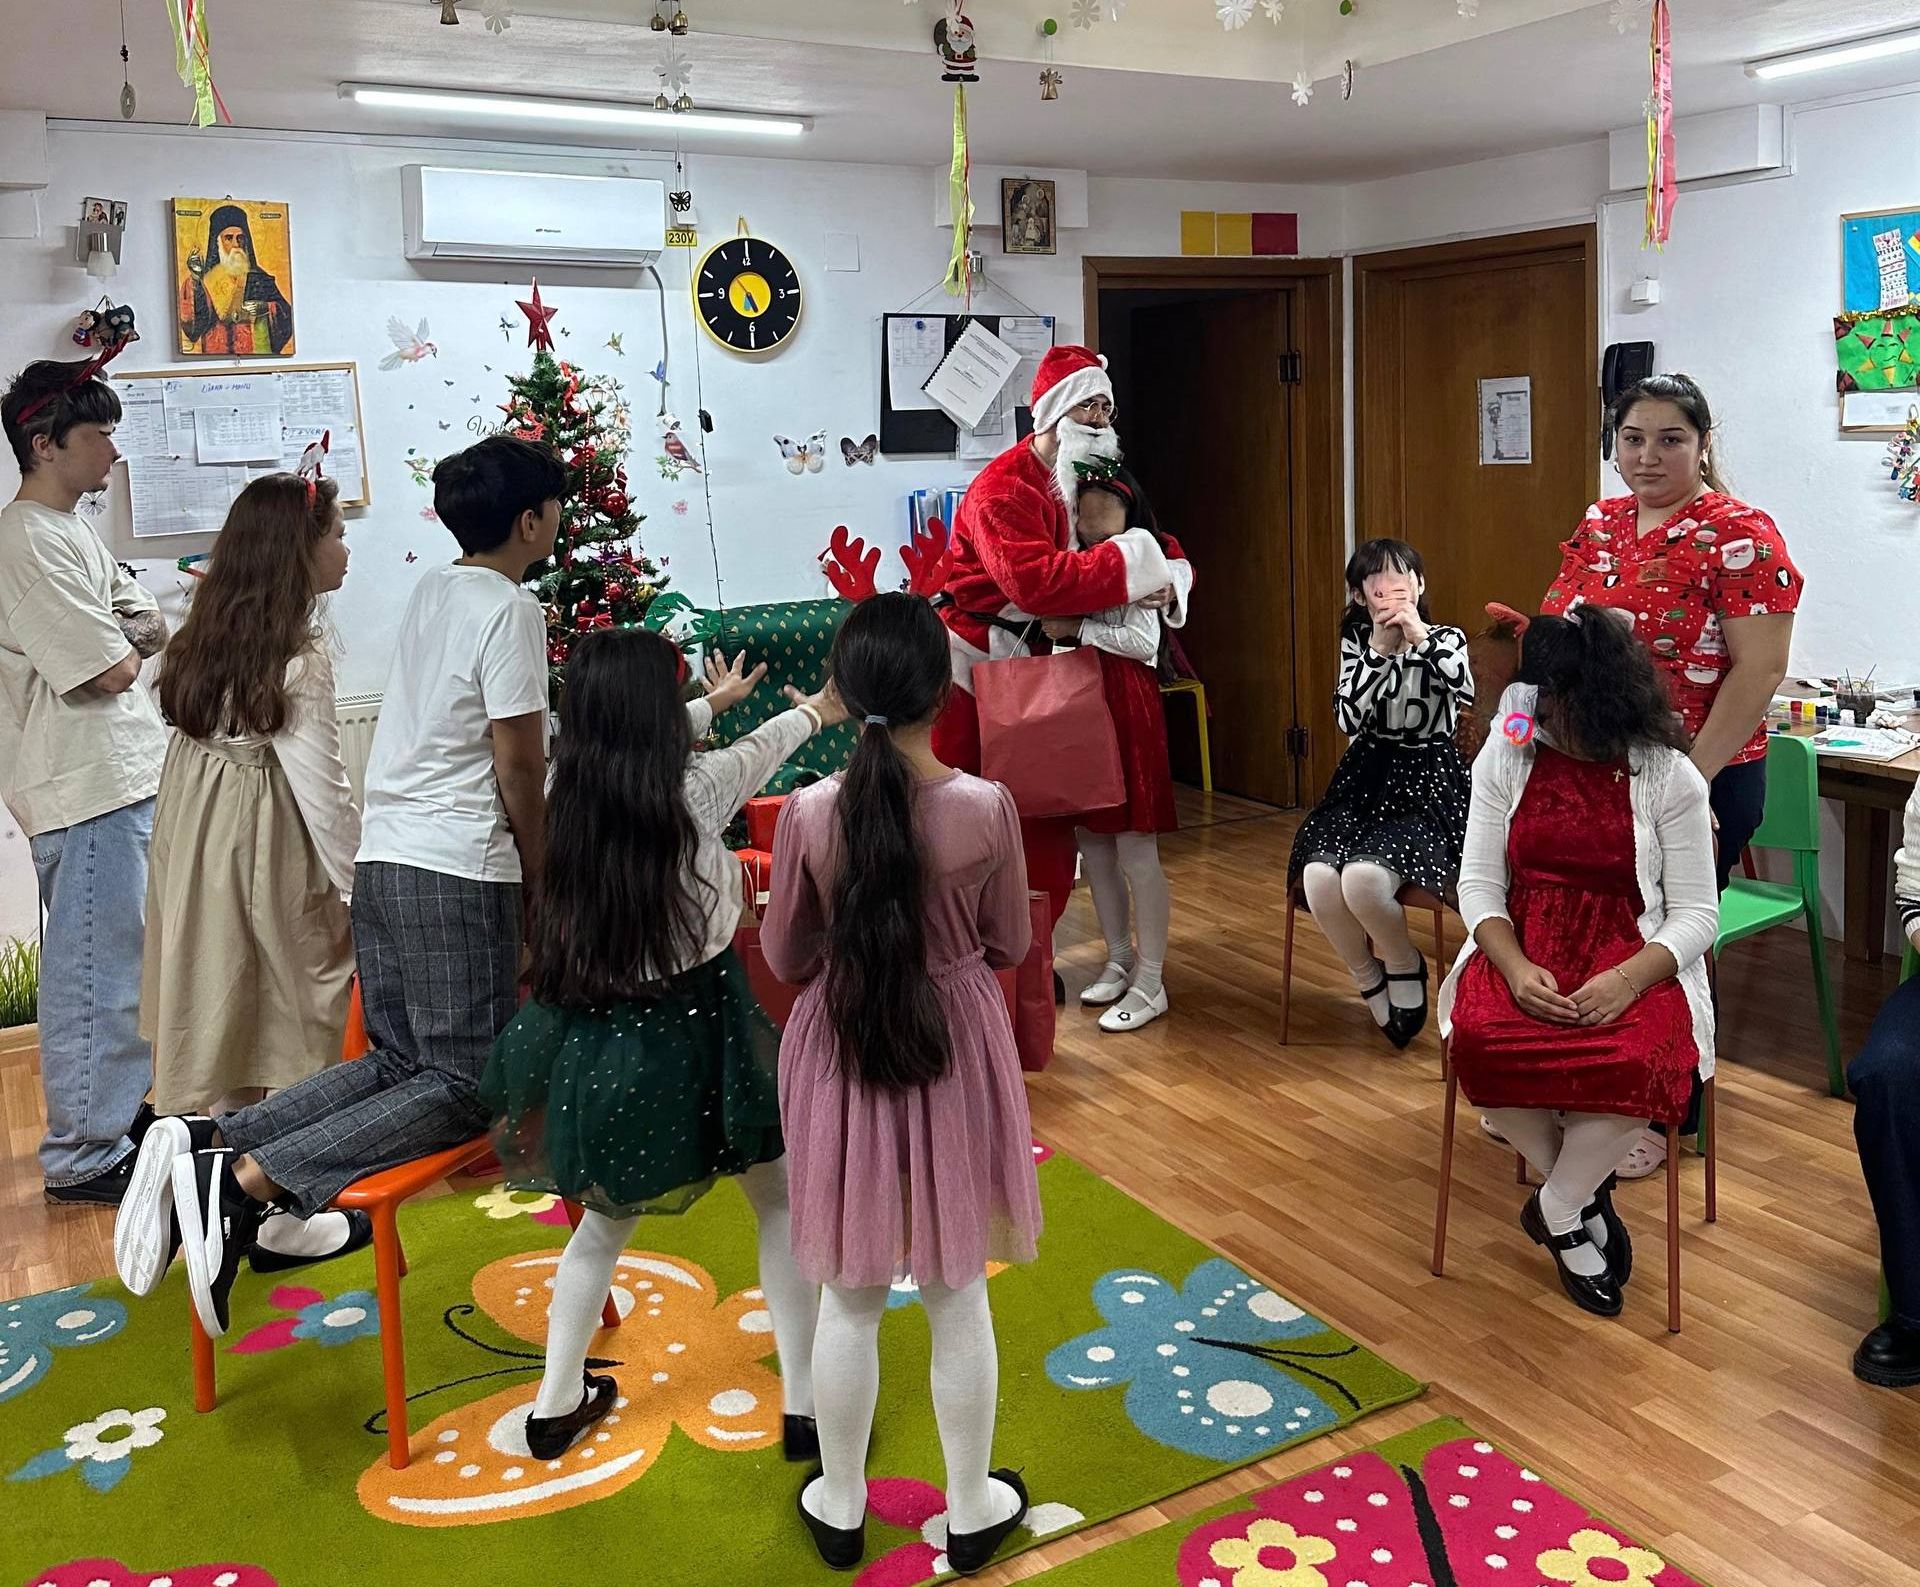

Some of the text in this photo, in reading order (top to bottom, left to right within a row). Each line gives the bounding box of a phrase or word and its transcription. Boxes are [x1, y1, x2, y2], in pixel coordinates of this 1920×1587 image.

[668, 232, 694, 243] 230V
[742, 257, 751, 266] 12
[717, 287, 726, 299] 9
[778, 288, 785, 299] 3
[749, 321, 756, 332] 6
